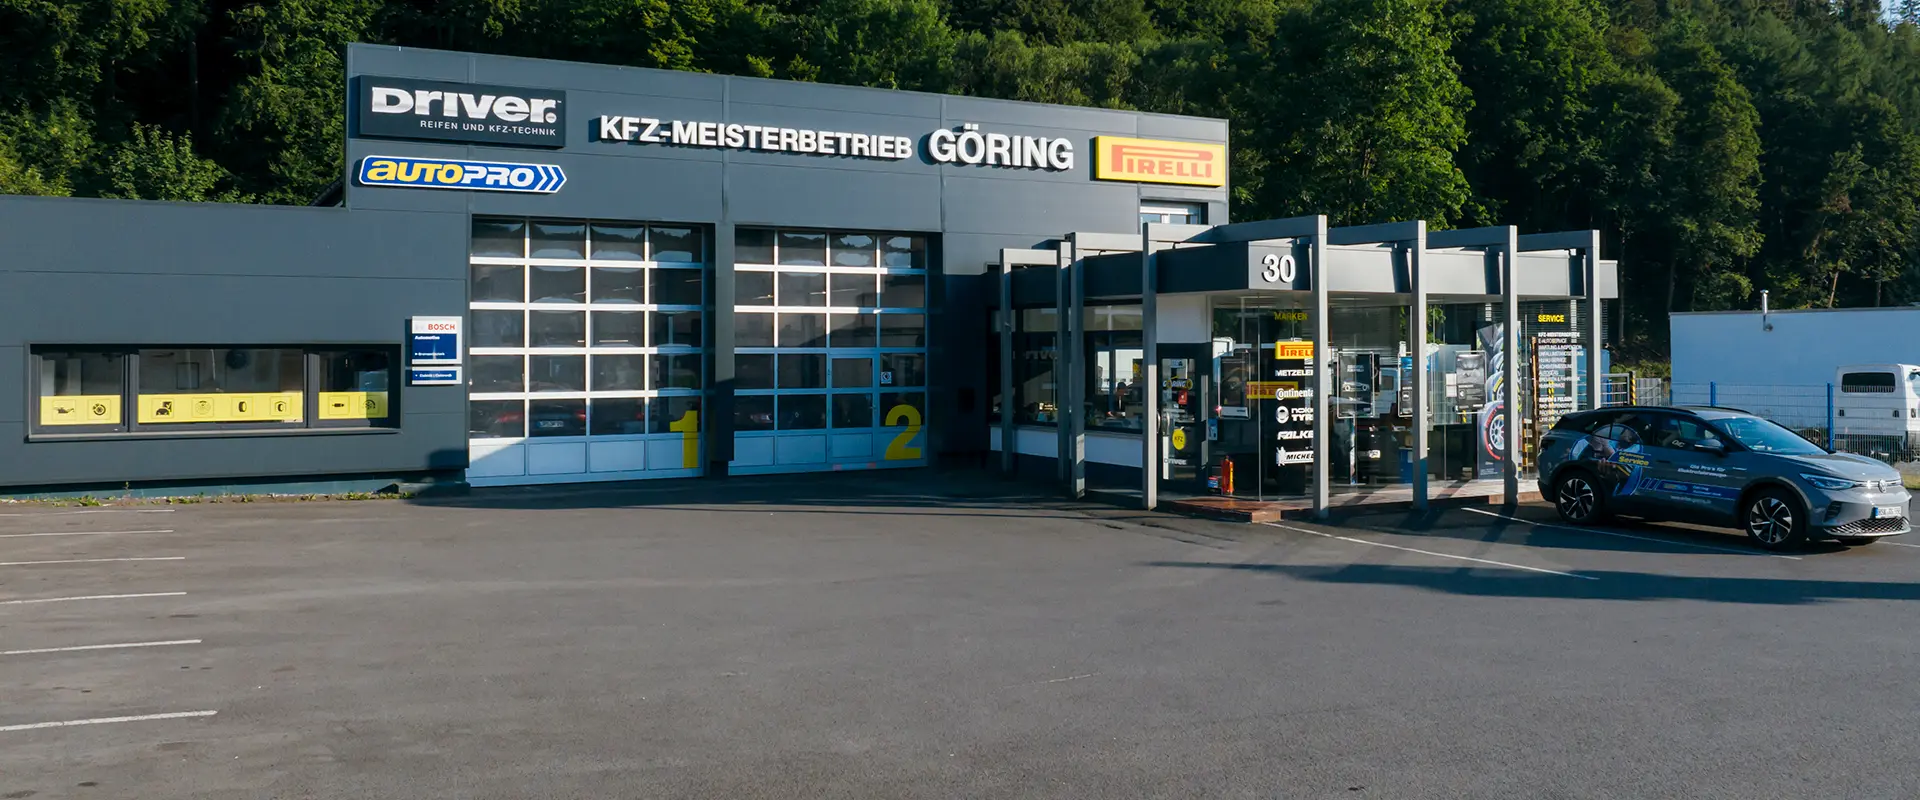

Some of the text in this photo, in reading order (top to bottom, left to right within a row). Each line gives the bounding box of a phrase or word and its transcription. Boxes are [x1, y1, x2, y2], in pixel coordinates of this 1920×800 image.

[420, 120, 556, 136] REIFEN UND KFZ-TECHNIK
[600, 115, 1074, 170] KFZ-MEISTERBETRIEB GÖRING
[1111, 144, 1213, 178] PIRELLI
[1263, 253, 1296, 283] 30
[1274, 312, 1308, 321] MARKEN
[1538, 314, 1565, 322] SERVICE
[428, 323, 456, 331] BOSCH
[1291, 413, 1314, 421] TYR
[884, 404, 922, 461] 2
[1277, 430, 1314, 440] FALKE
[669, 410, 699, 469] 1
[1618, 455, 1649, 466] Service
